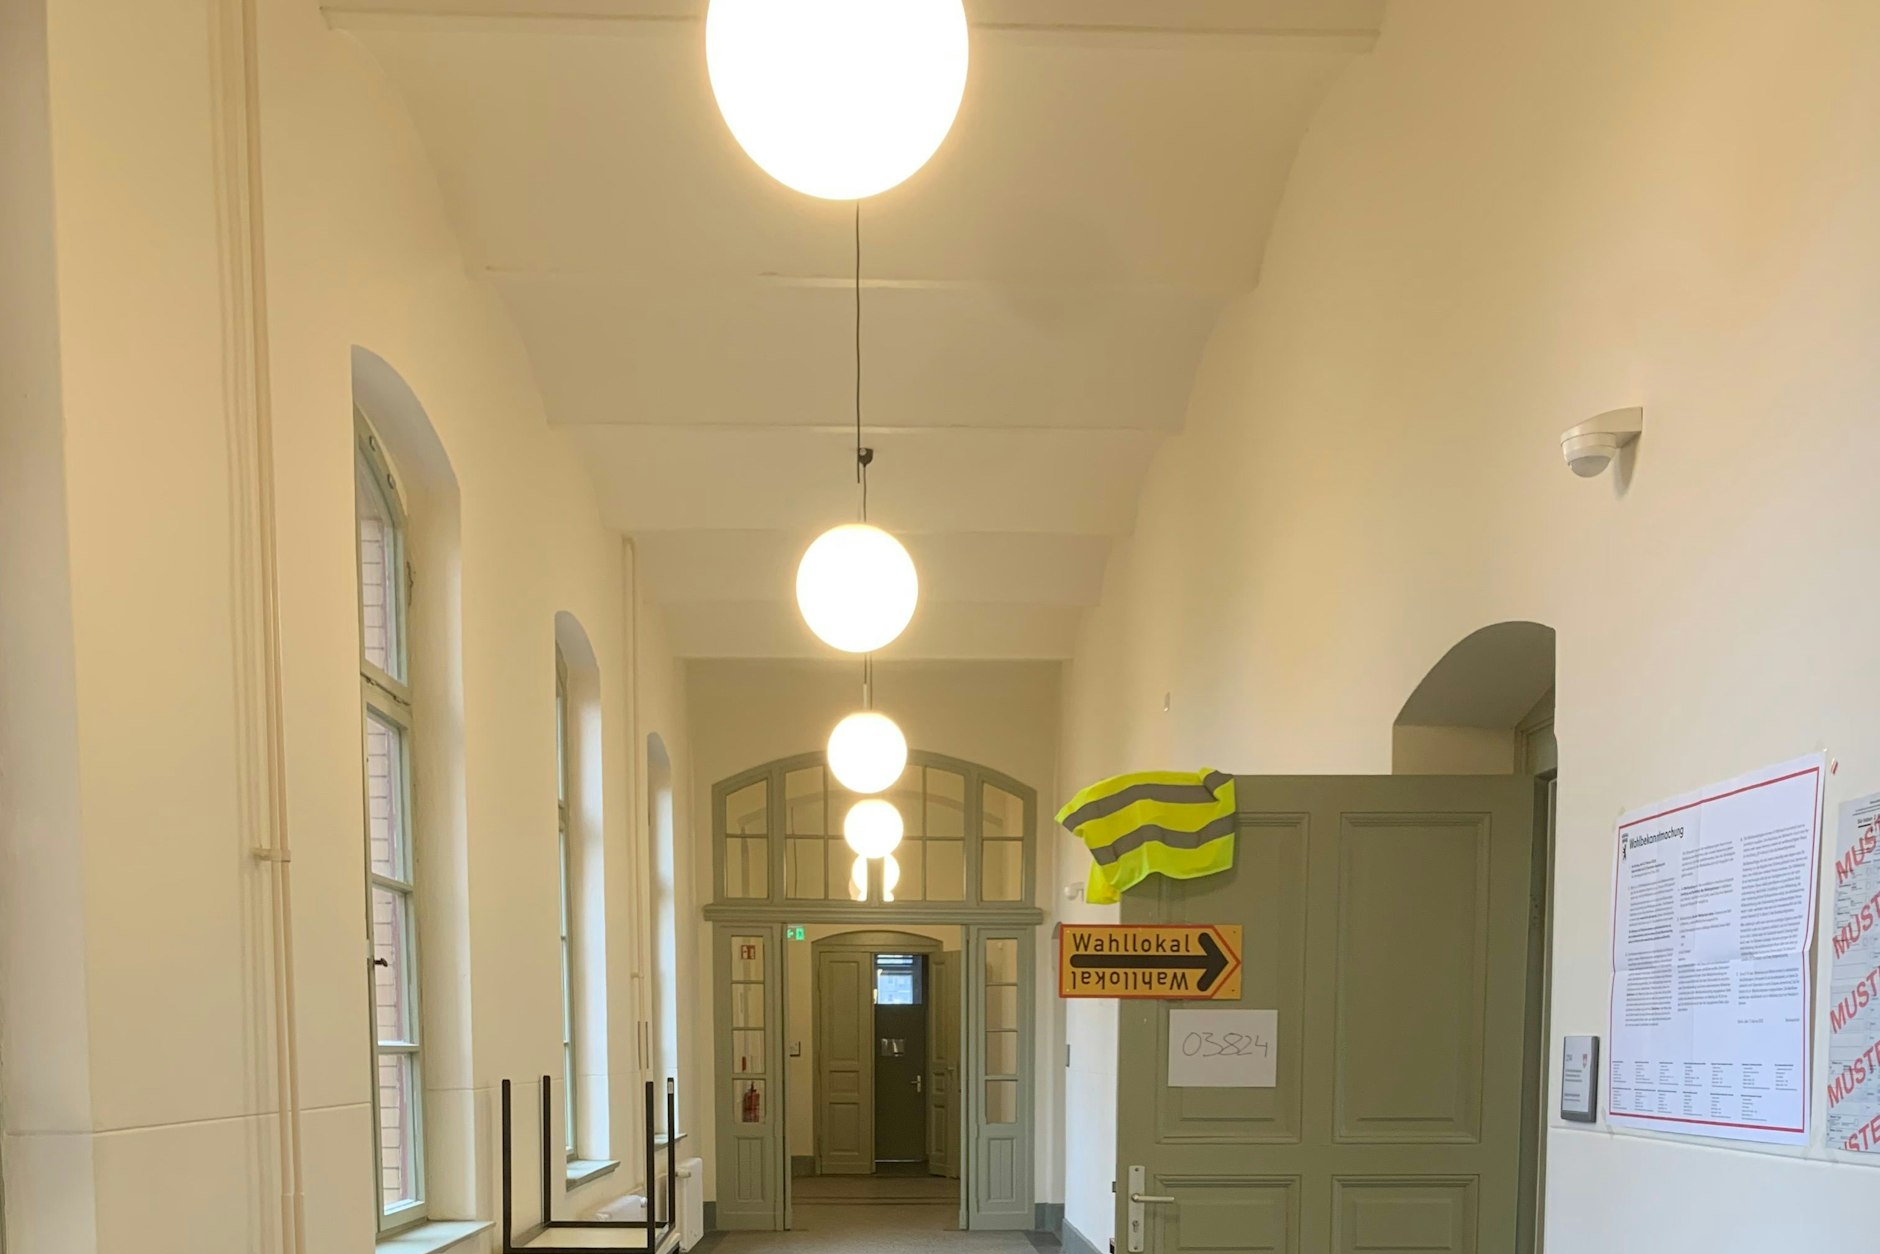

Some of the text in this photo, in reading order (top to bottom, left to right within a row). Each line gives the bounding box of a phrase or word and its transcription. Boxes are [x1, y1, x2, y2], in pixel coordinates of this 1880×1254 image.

[1628, 826, 1684, 849] Wahlbekanntmachung
[1072, 933, 1191, 952] Wahllokal
[1071, 971, 1189, 990] Wahllokal
[1182, 1031, 1268, 1058] 03824
